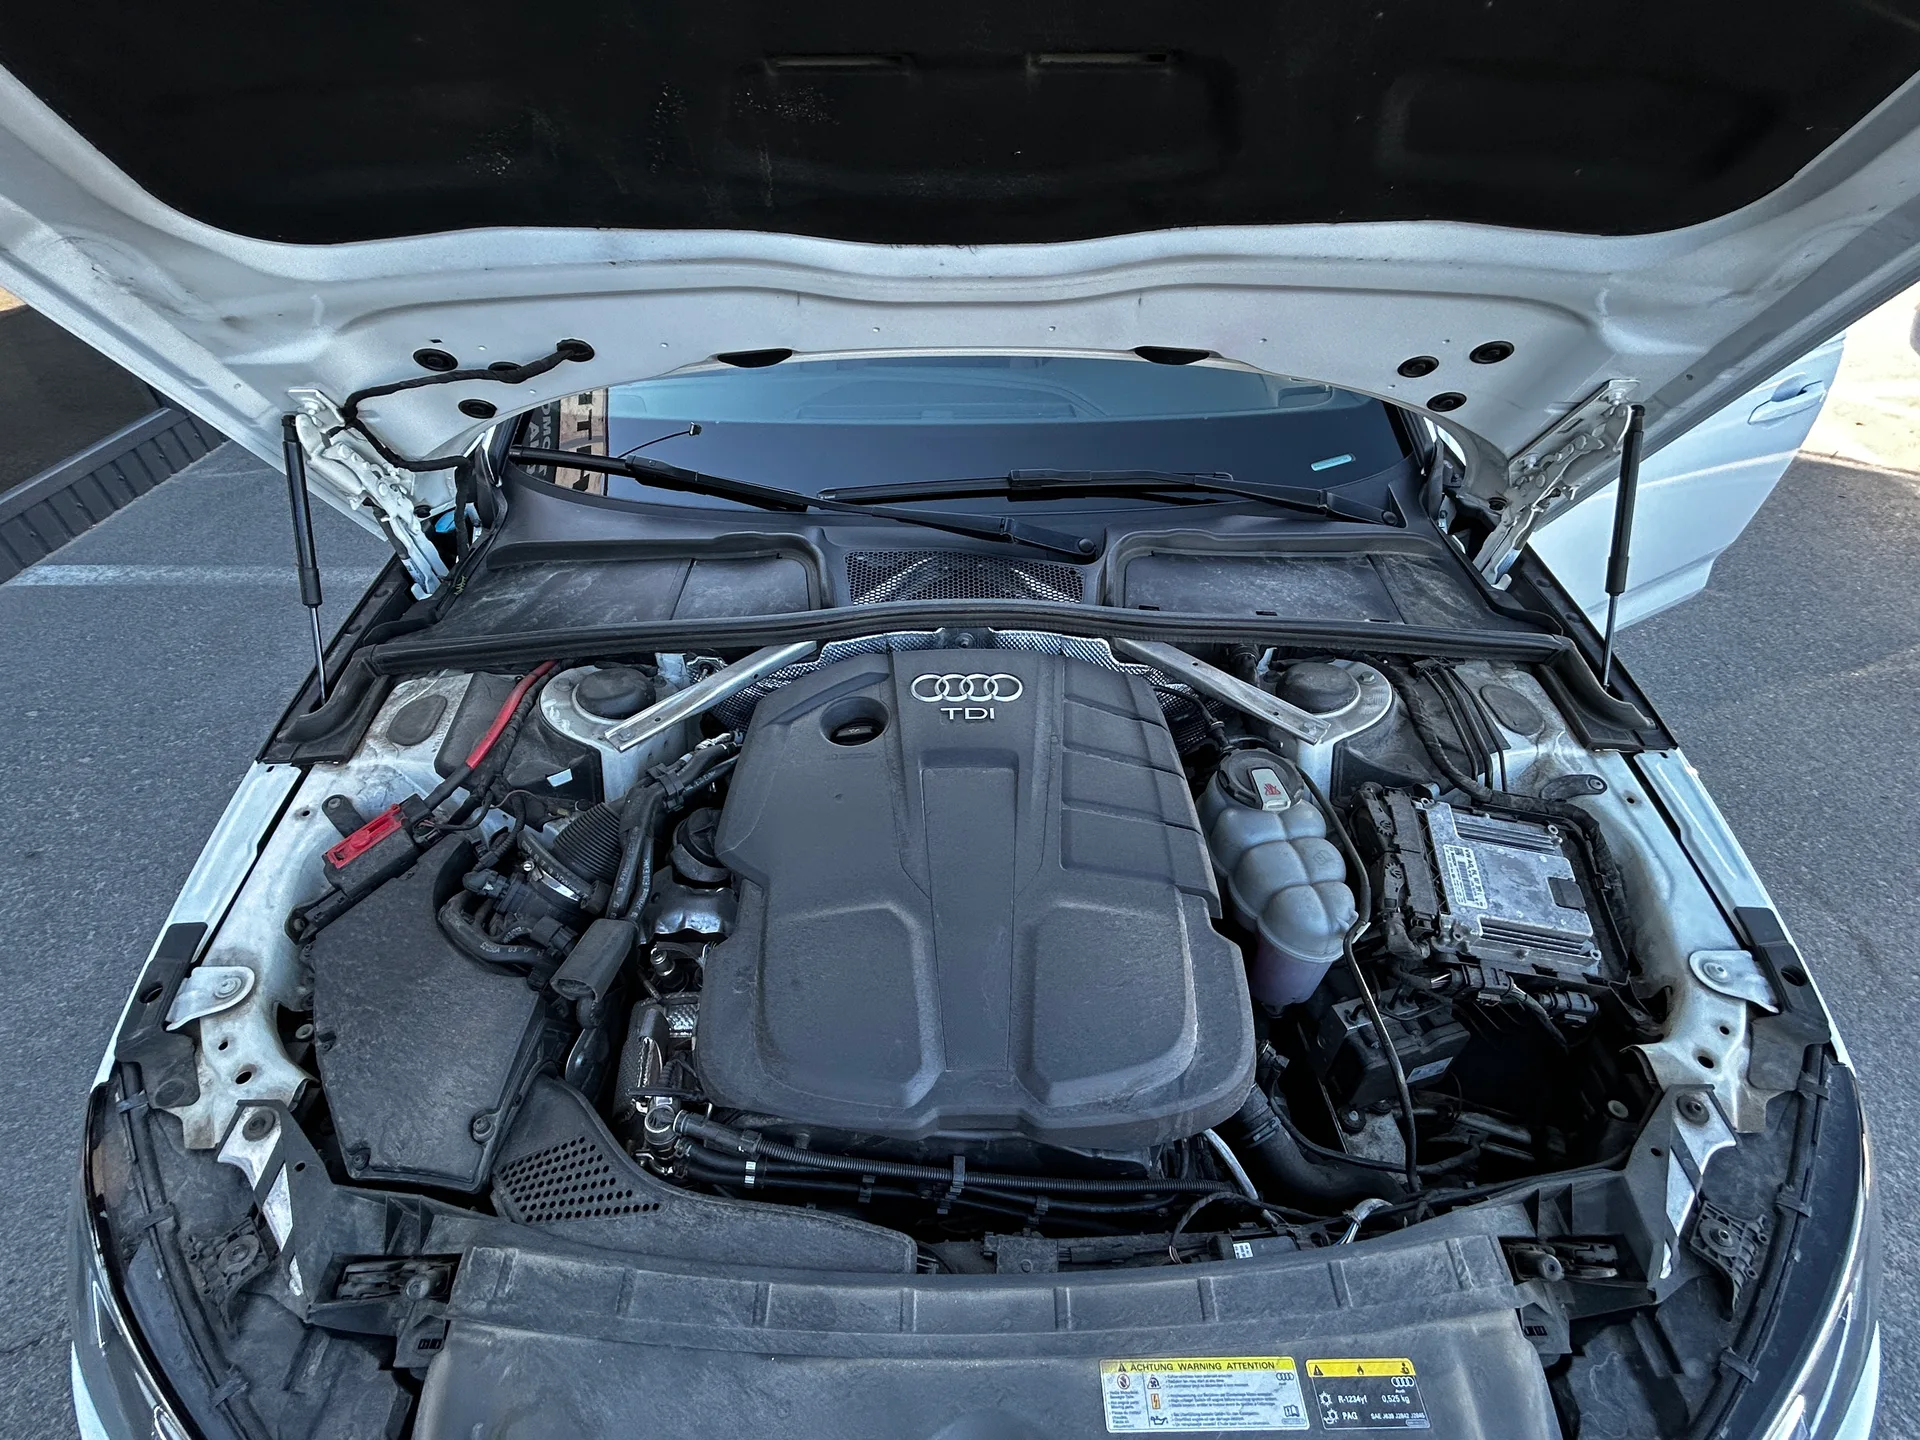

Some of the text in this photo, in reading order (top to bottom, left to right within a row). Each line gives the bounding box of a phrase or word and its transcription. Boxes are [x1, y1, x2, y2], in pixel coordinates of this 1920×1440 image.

[940, 707, 995, 720] TDI
[1130, 1361, 1275, 1371] ACHTUNG WARNING ATTENTION
[1337, 1394, 1368, 1405] R-1234yf
[1401, 1394, 1411, 1404] kg
[1342, 1411, 1358, 1420] PAG
[1370, 1412, 1382, 1420] SAE
